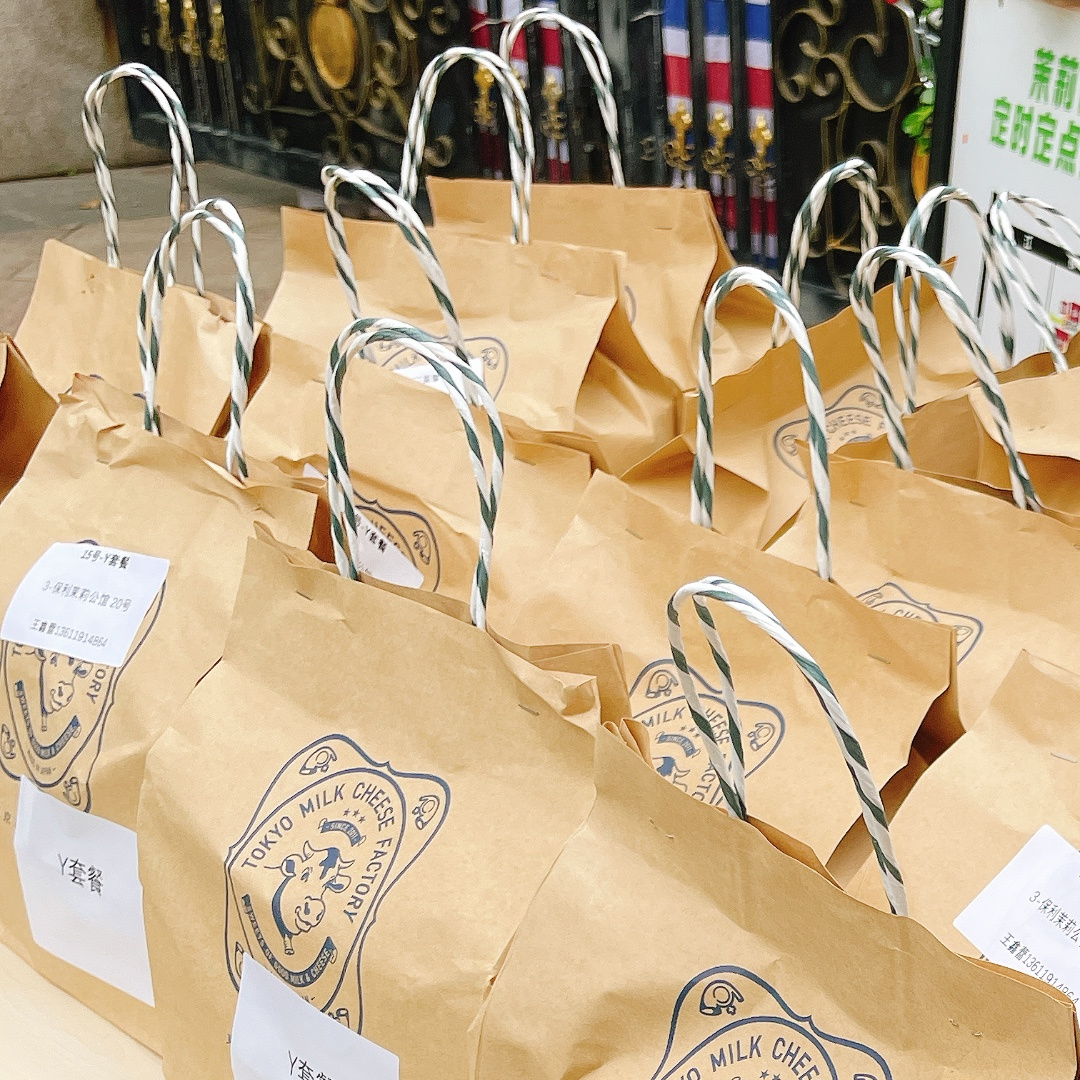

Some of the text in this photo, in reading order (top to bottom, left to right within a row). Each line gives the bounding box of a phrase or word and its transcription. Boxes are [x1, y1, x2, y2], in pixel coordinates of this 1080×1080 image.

[110, 597, 132, 612] 20号
[642, 706, 686, 728] MILK
[241, 782, 395, 923] TOKYO MILK CHEESE FACTORY
[57, 853, 104, 897] Y套餐
[710, 1035, 763, 1072] MILK
